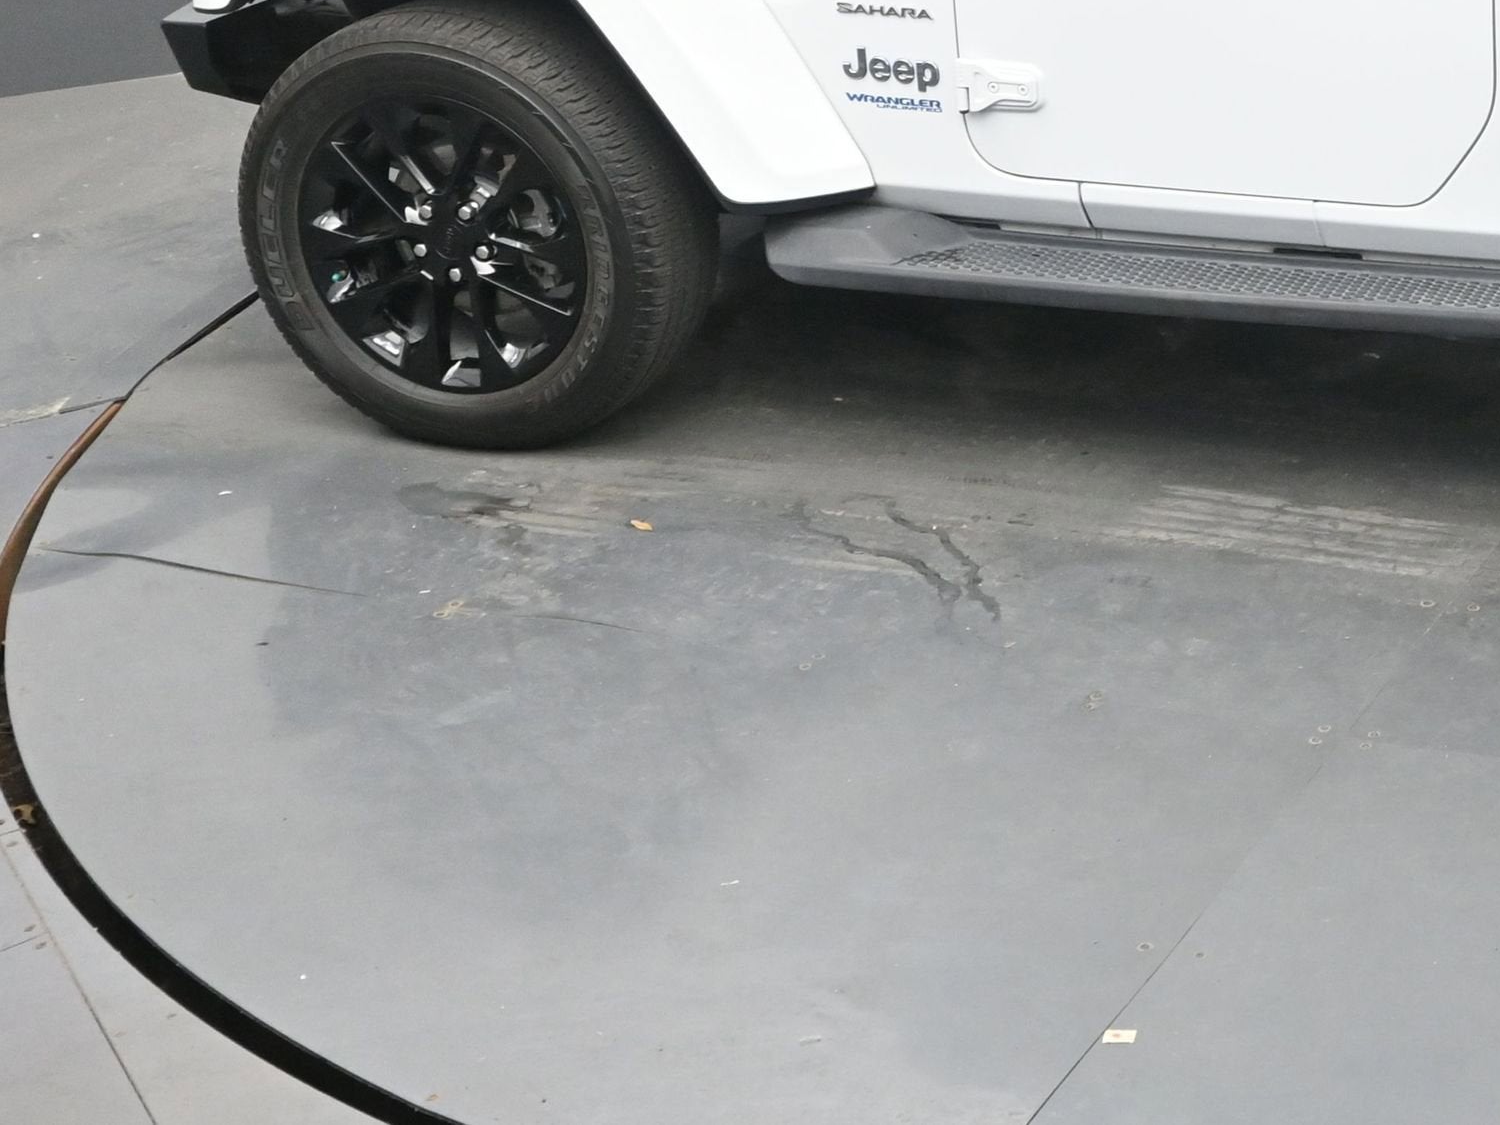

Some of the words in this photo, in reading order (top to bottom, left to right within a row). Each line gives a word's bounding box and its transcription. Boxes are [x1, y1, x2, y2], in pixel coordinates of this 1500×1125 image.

[836, 2, 933, 21] SAHARA
[842, 47, 941, 92] Jeep
[846, 92, 941, 109] WRANGLER
